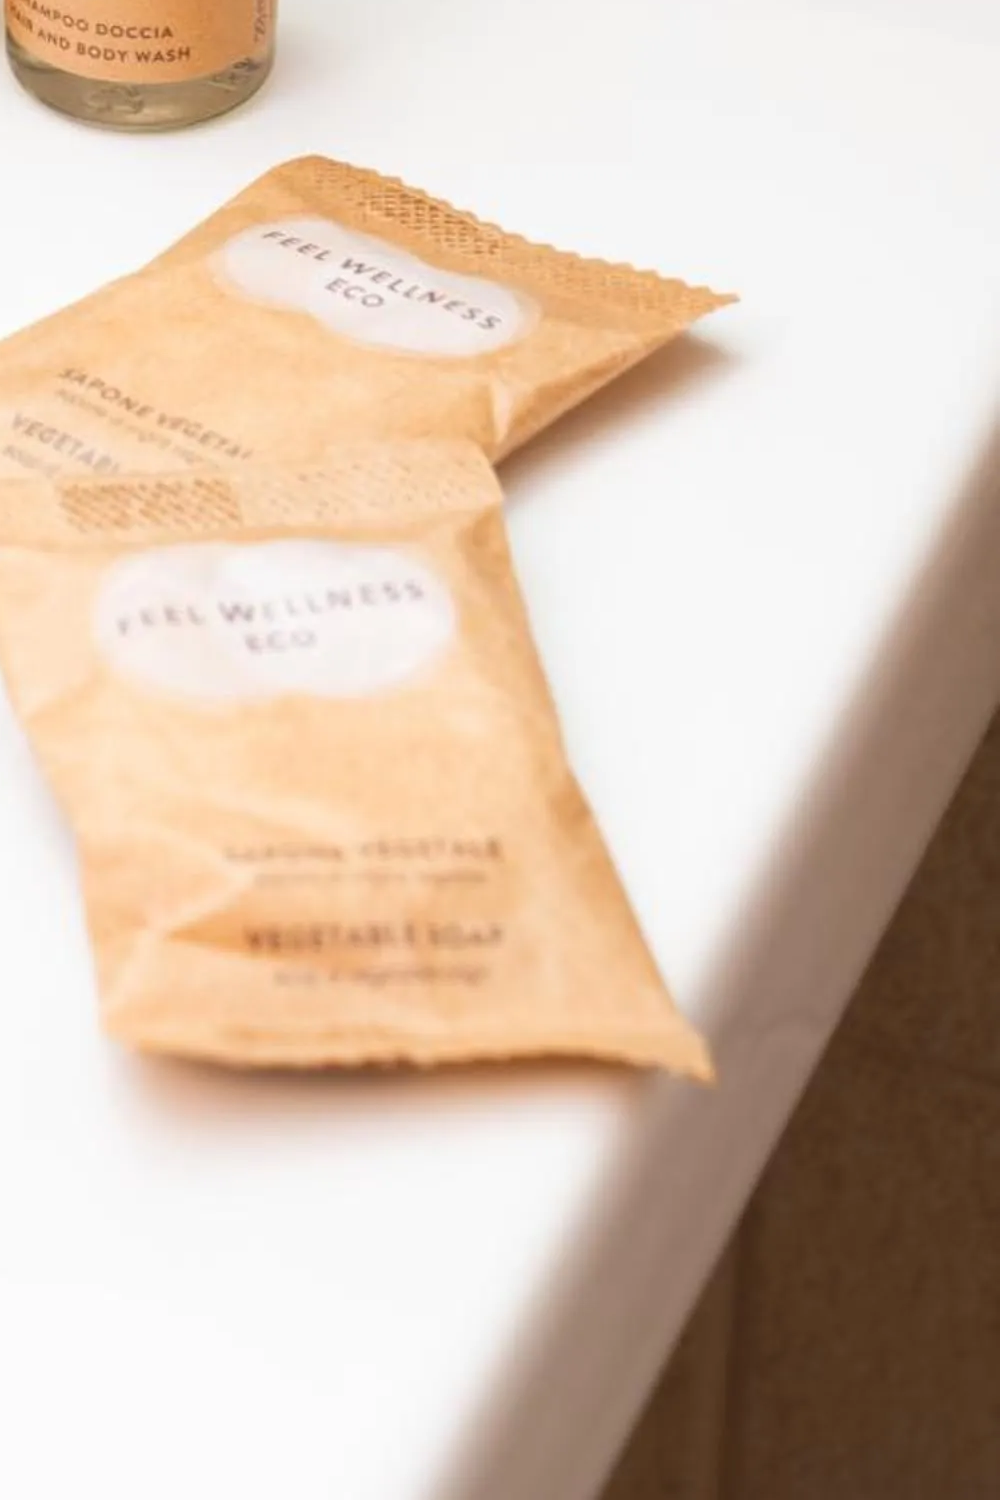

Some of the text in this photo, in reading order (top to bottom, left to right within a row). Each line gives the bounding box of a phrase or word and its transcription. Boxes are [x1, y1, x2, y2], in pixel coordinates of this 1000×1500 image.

[37, 29, 71, 51] AND
[76, 42, 128, 63] BODY
[134, 47, 191, 64] WASH
[95, 23, 174, 39] DOCCIA
[262, 231, 502, 330] FEEL WELLNESS
[325, 277, 385, 308] ECO
[59, 368, 154, 417] SAPONE
[116, 580, 425, 638] FEEL WELLNESS
[245, 630, 316, 654] ECO
